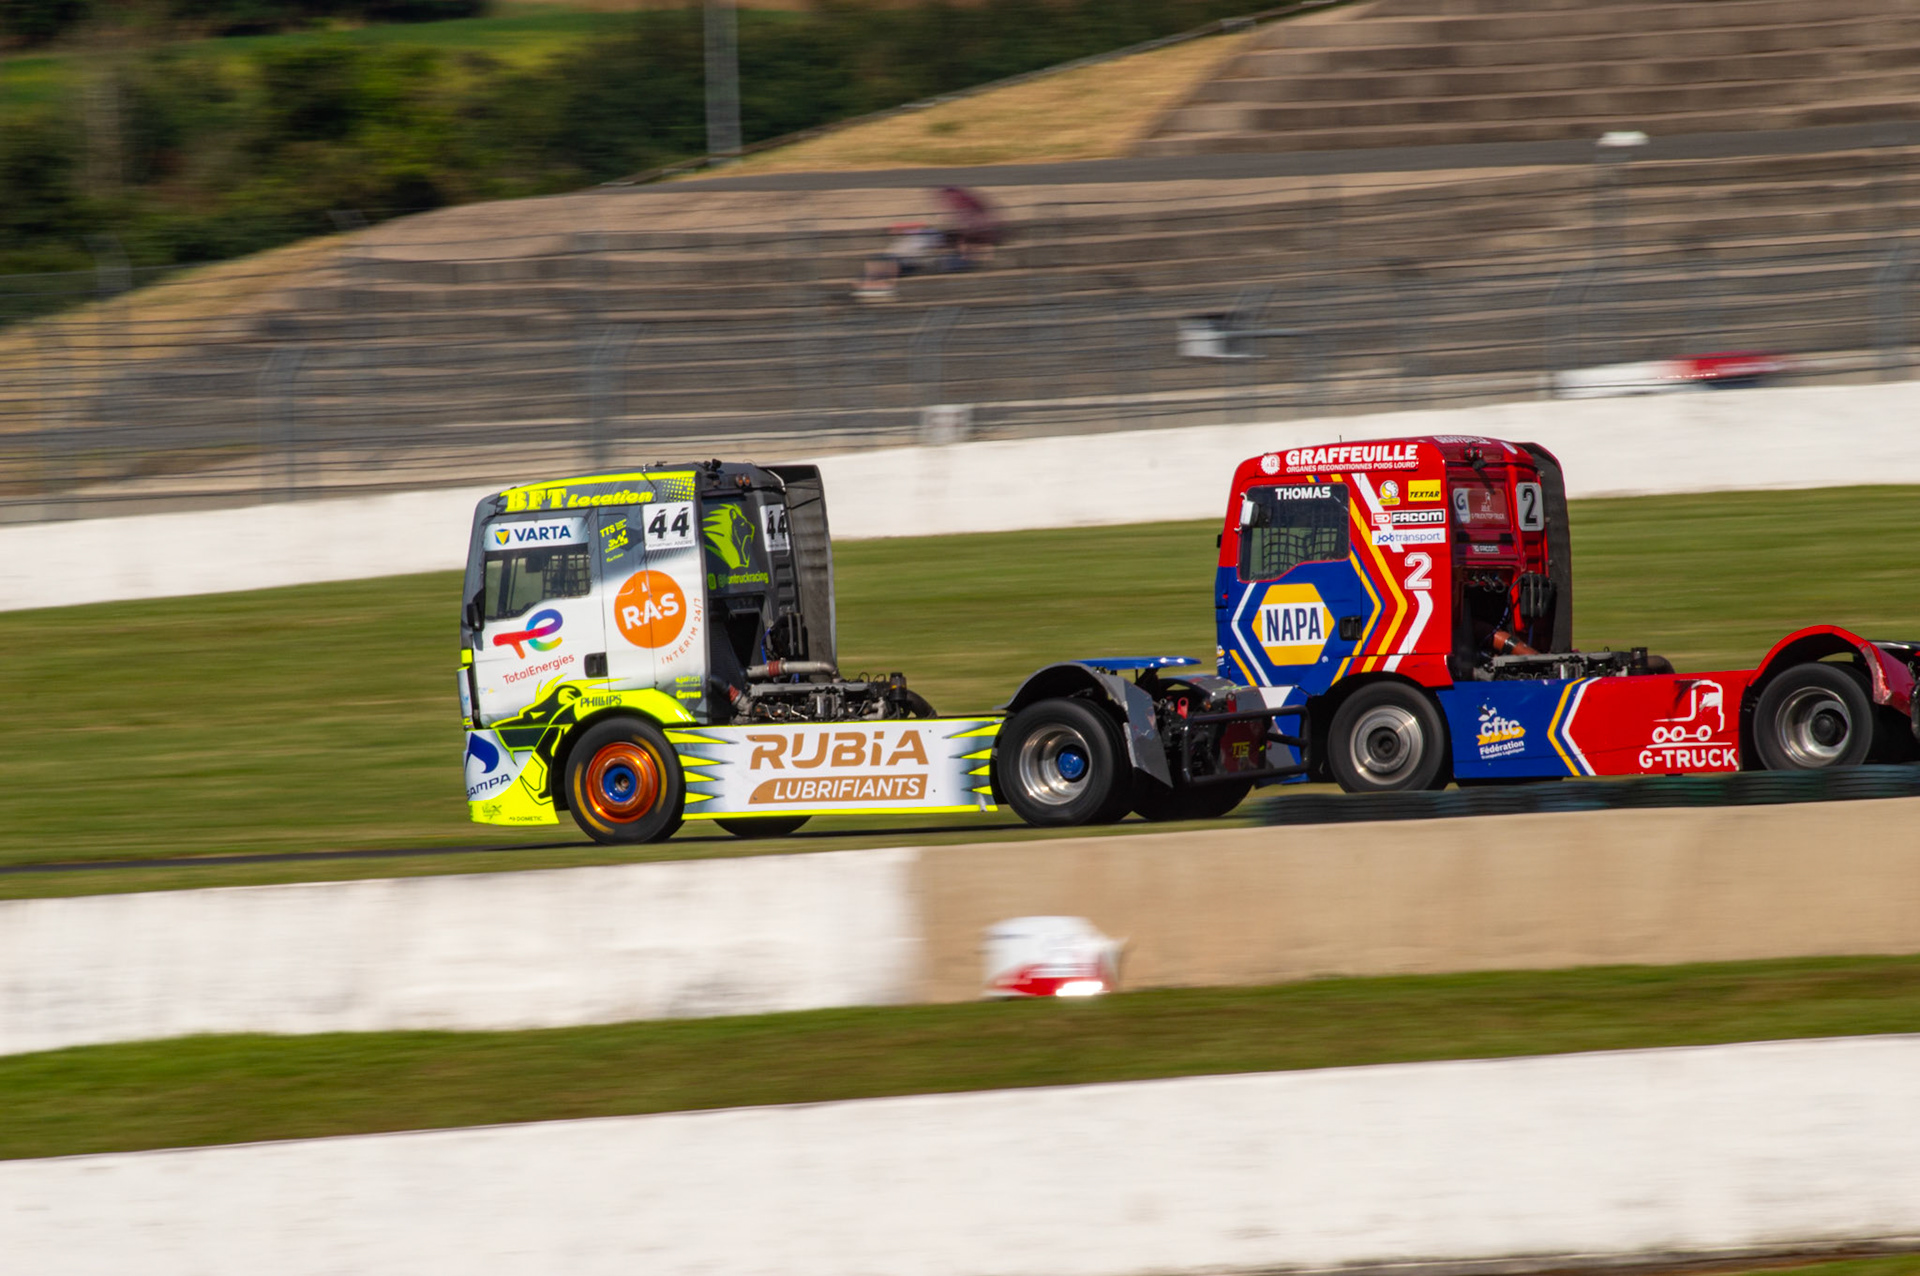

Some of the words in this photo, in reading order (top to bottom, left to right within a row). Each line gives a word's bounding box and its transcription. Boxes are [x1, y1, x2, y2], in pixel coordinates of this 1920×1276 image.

[1286, 444, 1418, 466] GRAFFEUILLE
[1286, 463, 1317, 473] ORGANES
[1373, 460, 1393, 470] POIDS
[500, 488, 567, 512] BFT
[567, 488, 654, 507] Location
[1275, 486, 1331, 500] THOMAS
[1409, 490, 1440, 498] TEXTAR
[1523, 485, 1538, 526] 2
[647, 507, 690, 539] 44
[766, 510, 787, 540] 44
[1392, 511, 1443, 523] FACOM
[514, 525, 571, 542] VARTA
[600, 524, 615, 538] TTS
[1404, 552, 1432, 590] 2
[1266, 606, 1322, 642] NAPA
[502, 653, 576, 685] TotalEnergies
[1480, 716, 1520, 737] cftc
[1638, 747, 1739, 769] G-TRUCK
[773, 777, 921, 800] LUBRIFIANTS
